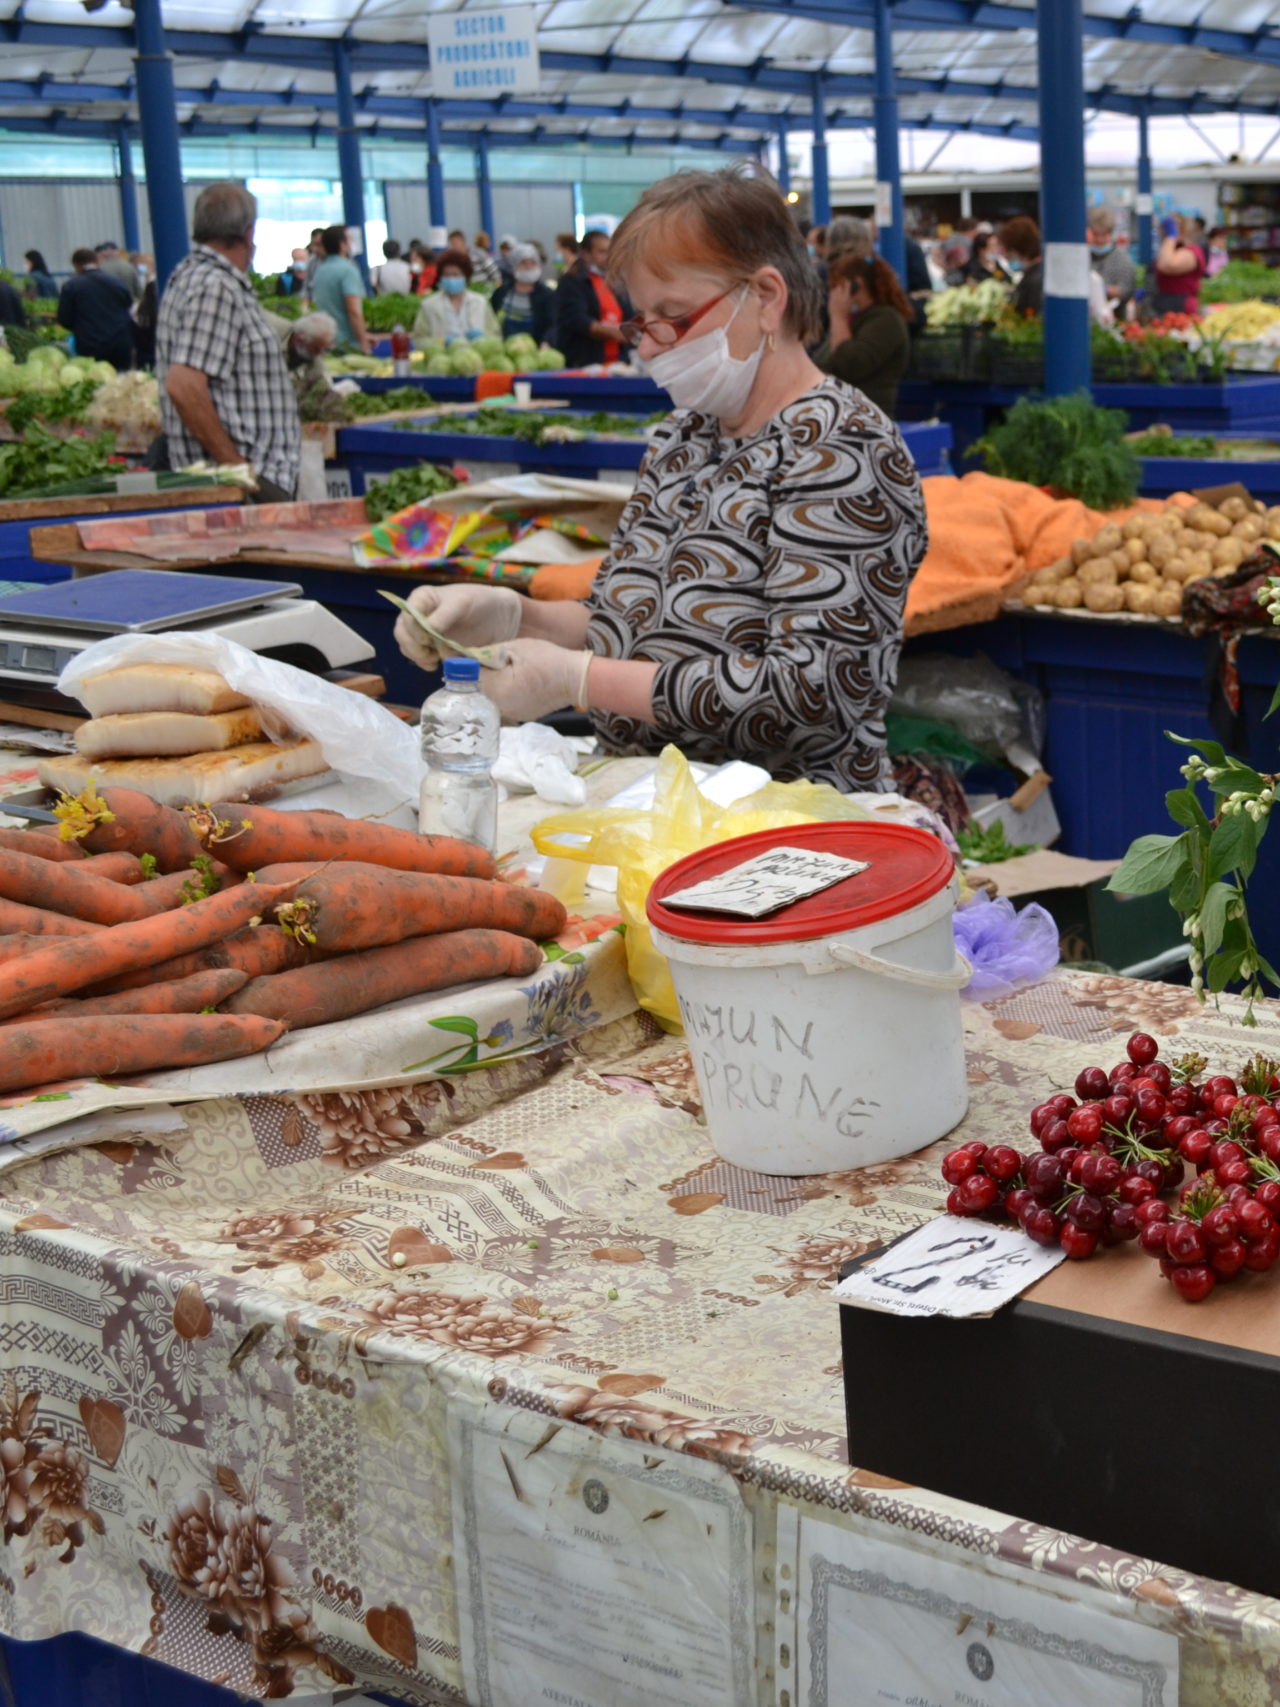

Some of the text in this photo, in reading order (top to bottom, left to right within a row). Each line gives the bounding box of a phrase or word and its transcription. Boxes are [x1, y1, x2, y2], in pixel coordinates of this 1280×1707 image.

[455, 15, 505, 37] SECTOR
[454, 67, 516, 88] AGRICOLI
[702, 1051, 882, 1138] PRUNE
